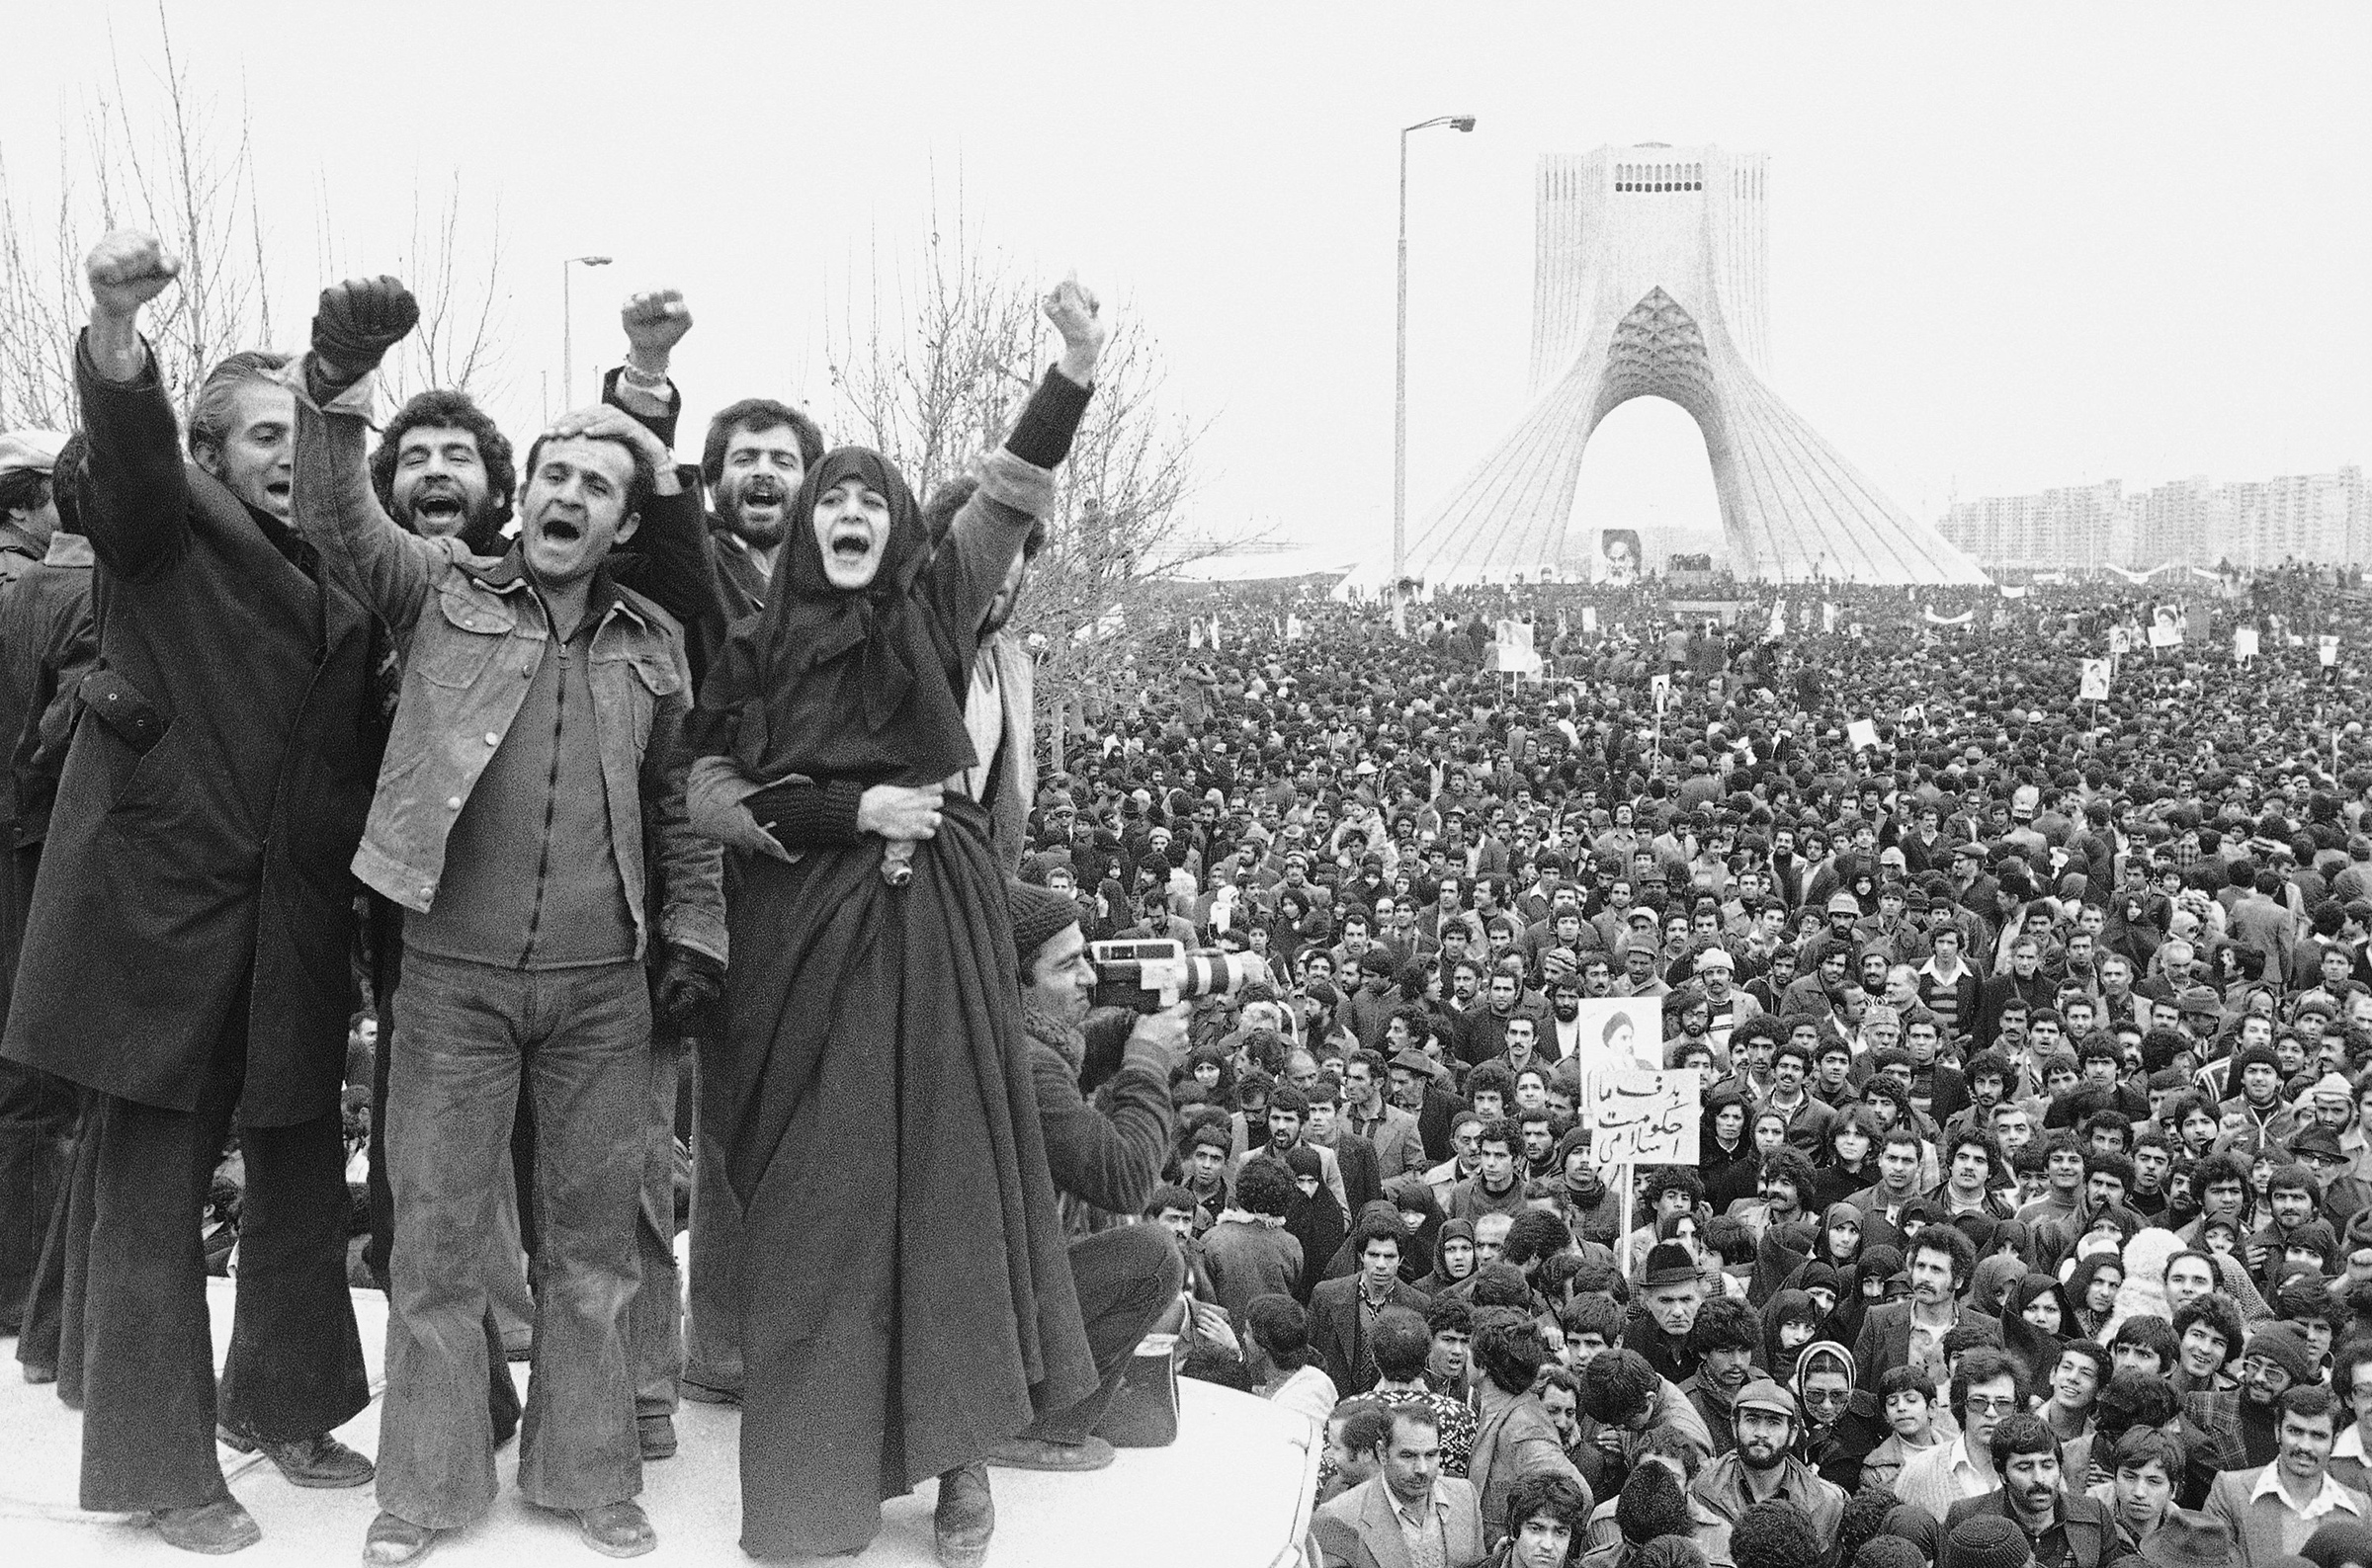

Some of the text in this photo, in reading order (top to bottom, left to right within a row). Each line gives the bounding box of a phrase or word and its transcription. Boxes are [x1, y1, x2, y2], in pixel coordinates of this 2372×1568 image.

[1599, 1075, 1679, 1105] هدف ما
[1598, 1102, 1690, 1137] حکومت
[1599, 1127, 1679, 1163] اسلامی
